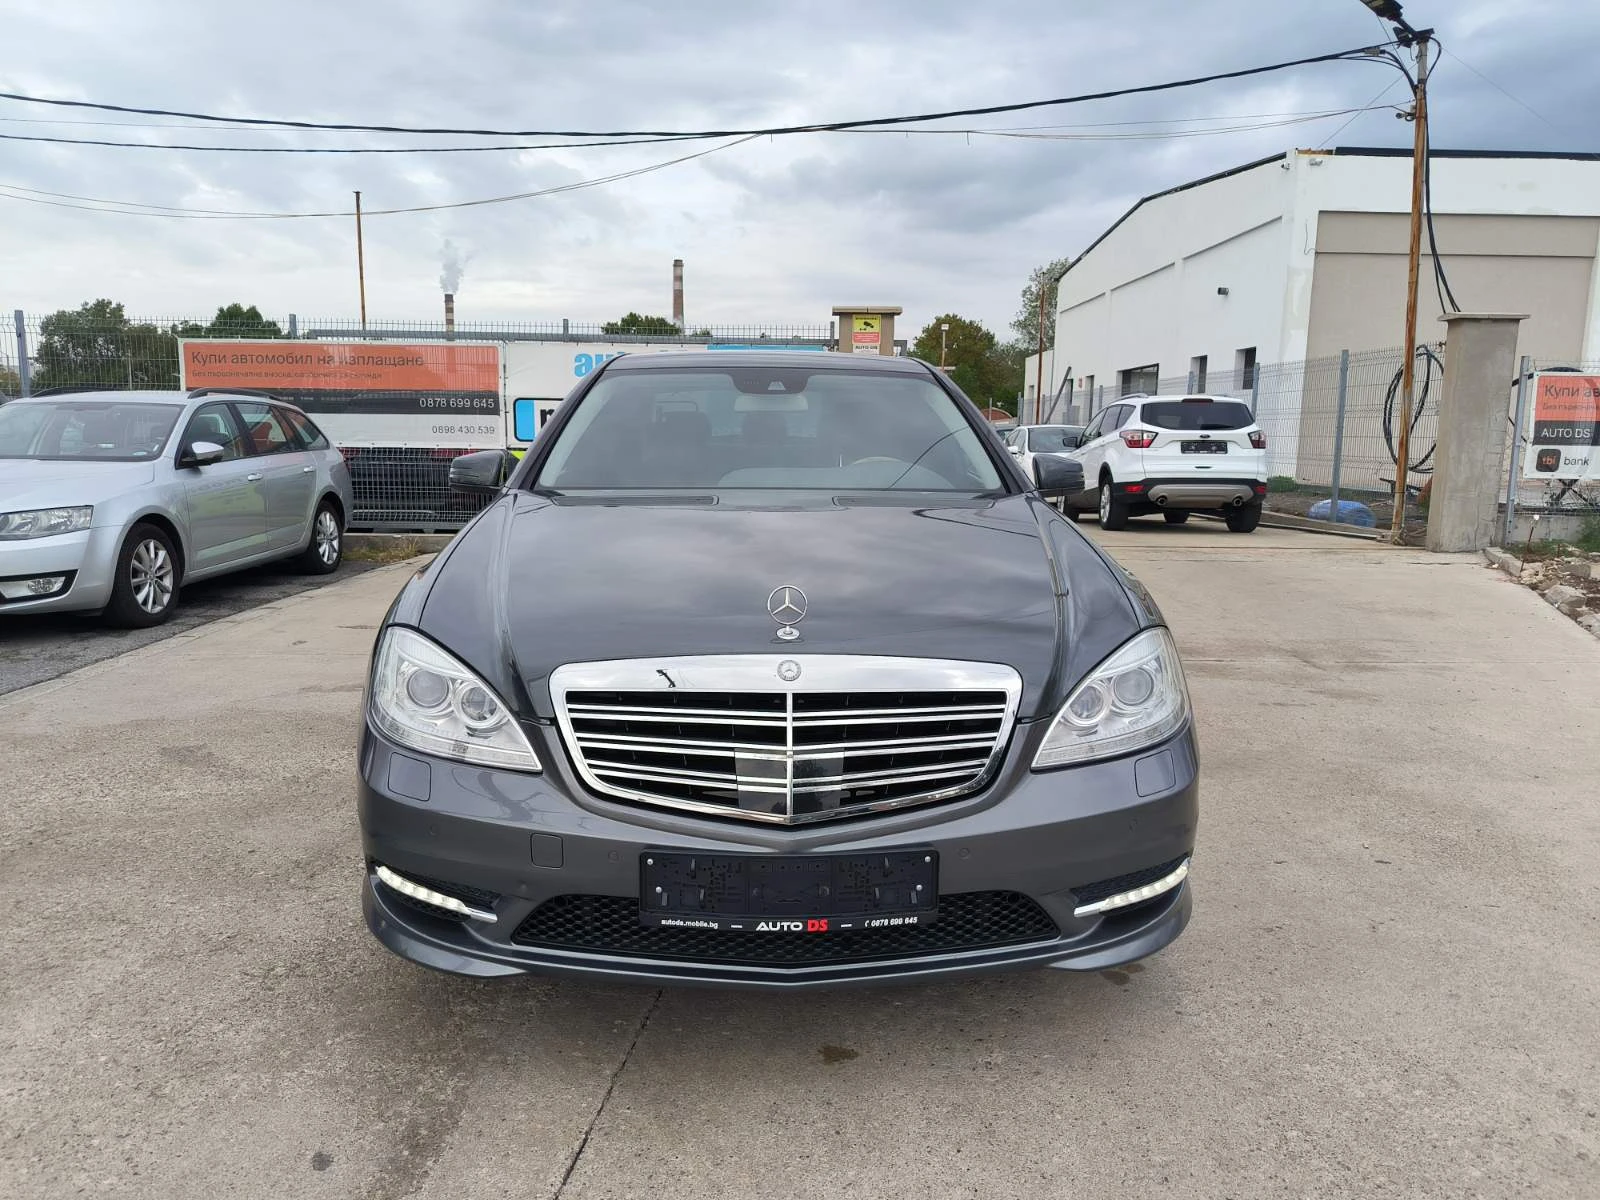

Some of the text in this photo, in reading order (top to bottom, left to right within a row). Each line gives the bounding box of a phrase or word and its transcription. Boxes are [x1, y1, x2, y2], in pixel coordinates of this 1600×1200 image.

[192, 352, 226, 366] Купи
[231, 353, 313, 364] автомобил
[317, 355, 335, 364] на
[1544, 384, 1580, 399] Купи
[420, 398, 495, 409] 0878 699 645
[432, 425, 495, 434] 0898 430 539
[1541, 428, 1591, 438] AUTO DS
[1563, 457, 1590, 466] bank
[756, 919, 829, 932] AUTO DS
